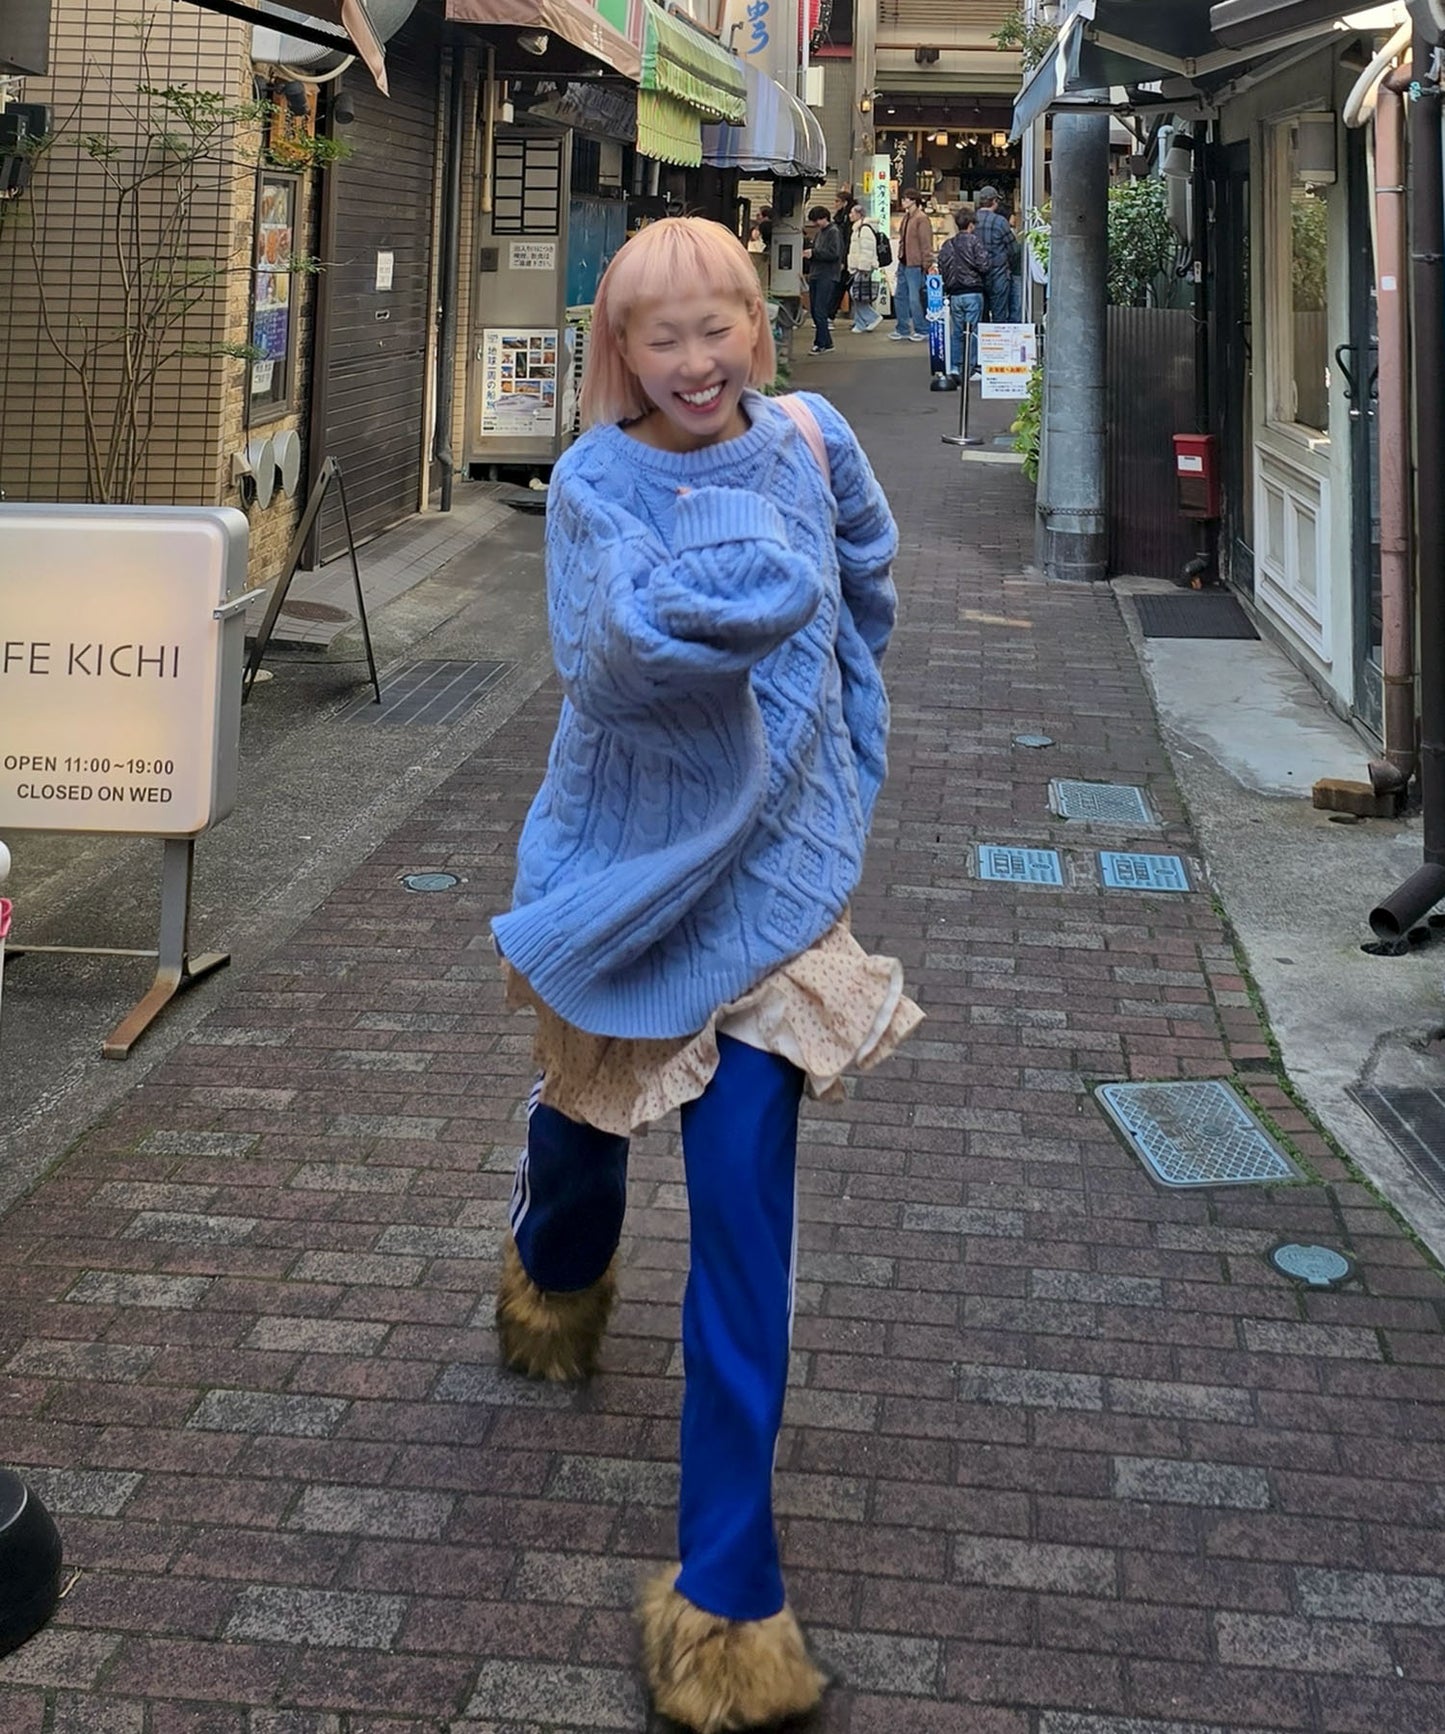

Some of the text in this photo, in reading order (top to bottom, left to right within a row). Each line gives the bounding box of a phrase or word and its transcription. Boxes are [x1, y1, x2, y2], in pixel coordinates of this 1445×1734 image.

[486, 346, 497, 411] 地球一周の船旅
[67, 642, 180, 678] KICHI
[4, 755, 58, 772] OPEN
[17, 783, 173, 803] CLOSED ON WED
